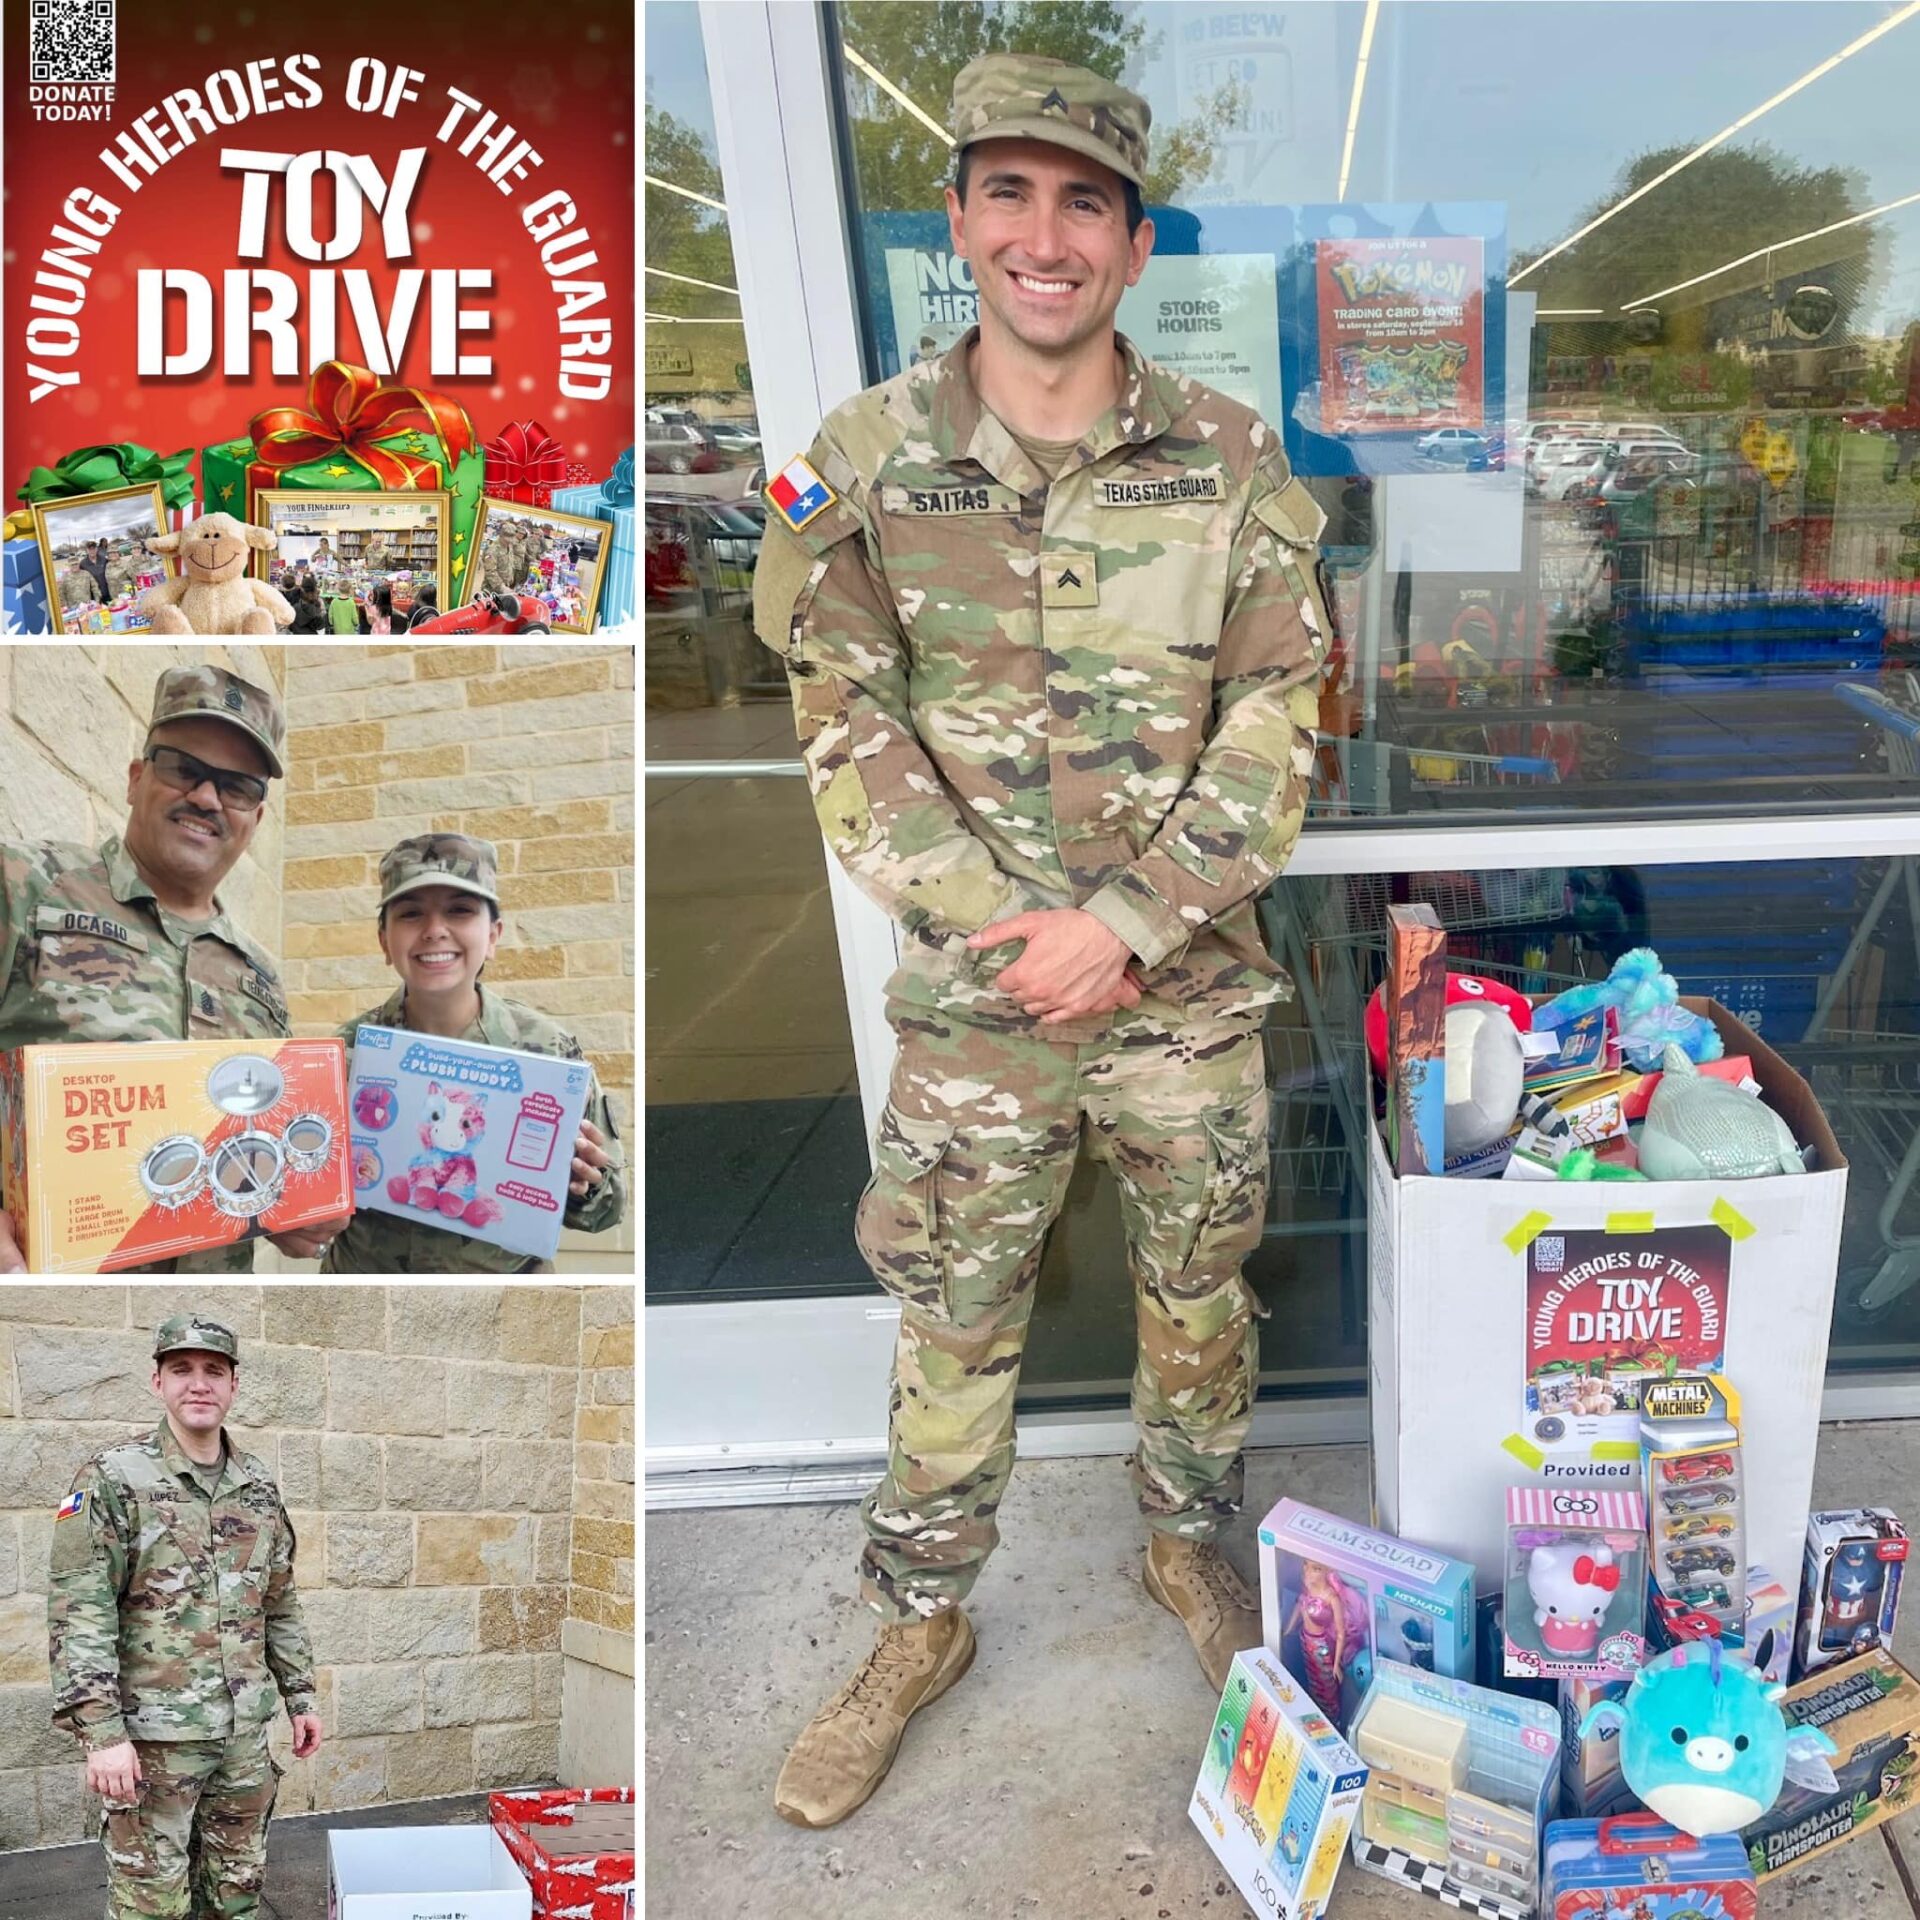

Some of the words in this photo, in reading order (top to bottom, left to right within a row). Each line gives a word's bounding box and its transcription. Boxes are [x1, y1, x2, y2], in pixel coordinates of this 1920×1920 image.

[30, 86, 116, 102] DONATE
[33, 105, 111, 121] TODAY!
[219, 146, 428, 261] TOY
[26, 187, 122, 403] YOUNG
[99, 53, 322, 193] HEROES
[345, 57, 425, 119] OF
[436, 86, 544, 196] THE
[522, 189, 613, 401] GUARD
[915, 252, 980, 291] NO
[136, 268, 493, 376] DRIVE
[1156, 317, 1223, 333] HOURS
[1347, 321, 1372, 329] stores
[1410, 319, 1452, 330] september
[1366, 329, 1385, 337] from
[1386, 329, 1408, 337] 10am
[1419, 329, 1436, 338] 2pm
[914, 488, 990, 513] SAITAS
[1103, 481, 1141, 503] TEXAS
[1142, 480, 1178, 502] STATE
[1178, 478, 1218, 498] GUARD
[64, 912, 129, 942] OCASIO
[63, 1074, 116, 1086] DESKTOP
[410, 1058, 457, 1077] PLUSH
[458, 1066, 512, 1088] BUDDY
[63, 1084, 167, 1118] DRUM
[65, 1120, 132, 1154] SET
[68, 1198, 72, 1206] 1
[75, 1194, 102, 1205] STAND
[69, 1207, 73, 1215] 1
[75, 1203, 106, 1214] CYMBAL
[67, 1226, 73, 1234] 2
[75, 1221, 101, 1233] SMALL
[103, 1216, 130, 1228] DRUMS
[75, 1213, 100, 1224] LARGE
[102, 1208, 123, 1220] DRUM
[67, 1235, 74, 1243] 2
[75, 1225, 126, 1242] DRUMSTICKS
[1533, 1290, 1565, 1350] YOUNG
[1557, 1251, 1631, 1292] HEROES
[1637, 1251, 1665, 1270] OF
[1665, 1258, 1701, 1288] THE
[1691, 1284, 1720, 1342] GUARD
[1596, 1275, 1665, 1311] TOY
[1568, 1307, 1683, 1343] DRIVE
[1652, 1385, 1706, 1402] METAL
[1652, 1400, 1706, 1417] MACHINES
[1544, 1464, 1631, 1477] Provided
[150, 1491, 179, 1502] LOPEZ
[1299, 1515, 1358, 1547] GLAM
[1360, 1538, 1433, 1573] SQUAD
[1394, 1590, 1447, 1617] MERMAID
[1789, 1672, 1872, 1718] DINOSAUR
[1801, 1685, 1885, 1727] TRANSPORTER
[1340, 1774, 1362, 1791] 100
[1768, 1799, 1853, 1855] DINOSAUR
[1767, 1816, 1853, 1872] TRANSPORTER
[1253, 1868, 1277, 1908] 100
